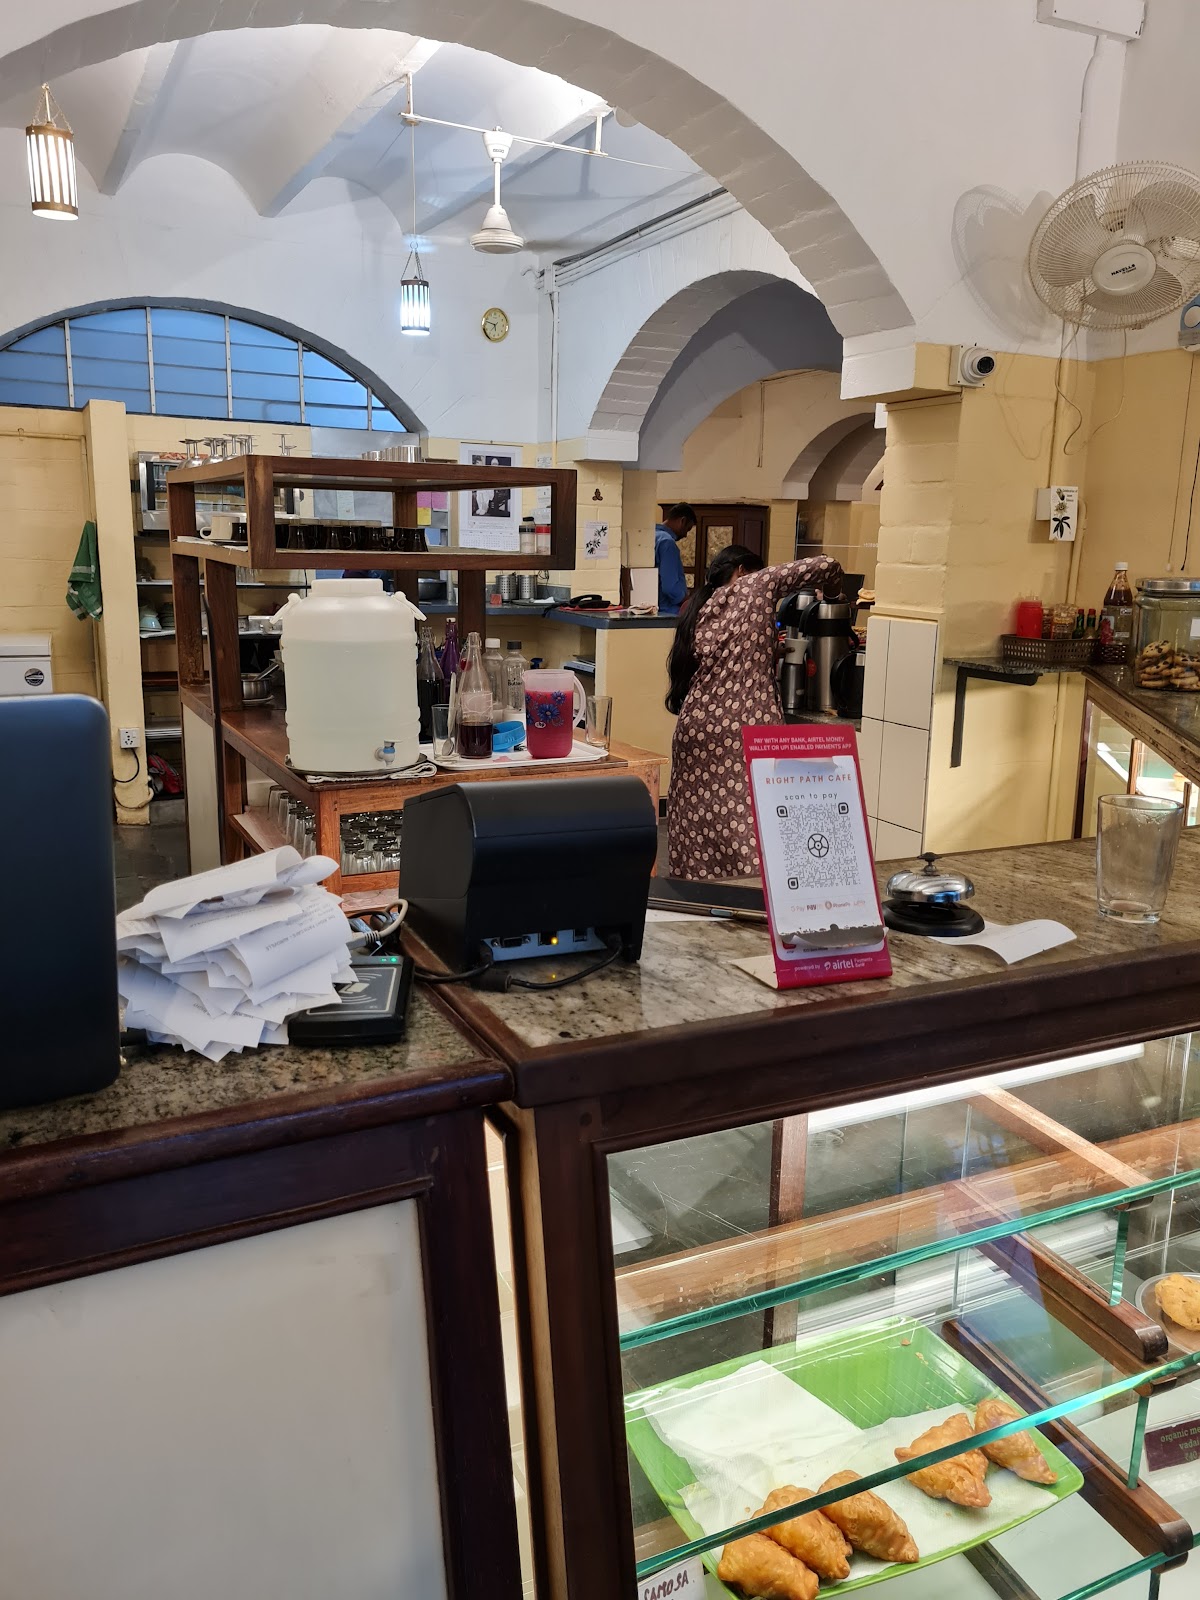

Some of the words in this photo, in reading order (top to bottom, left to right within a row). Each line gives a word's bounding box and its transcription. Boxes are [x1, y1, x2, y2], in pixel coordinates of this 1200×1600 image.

[765, 776, 795, 785] RIGHT
[800, 775, 824, 783] PATH
[828, 773, 852, 782] CAFE
[784, 793, 805, 801] scan
[822, 792, 838, 800] pay
[794, 964, 814, 972] powered
[832, 959, 854, 970] airtel
[1161, 1430, 1189, 1442] organic
[644, 1570, 688, 1600] SAMOSA
